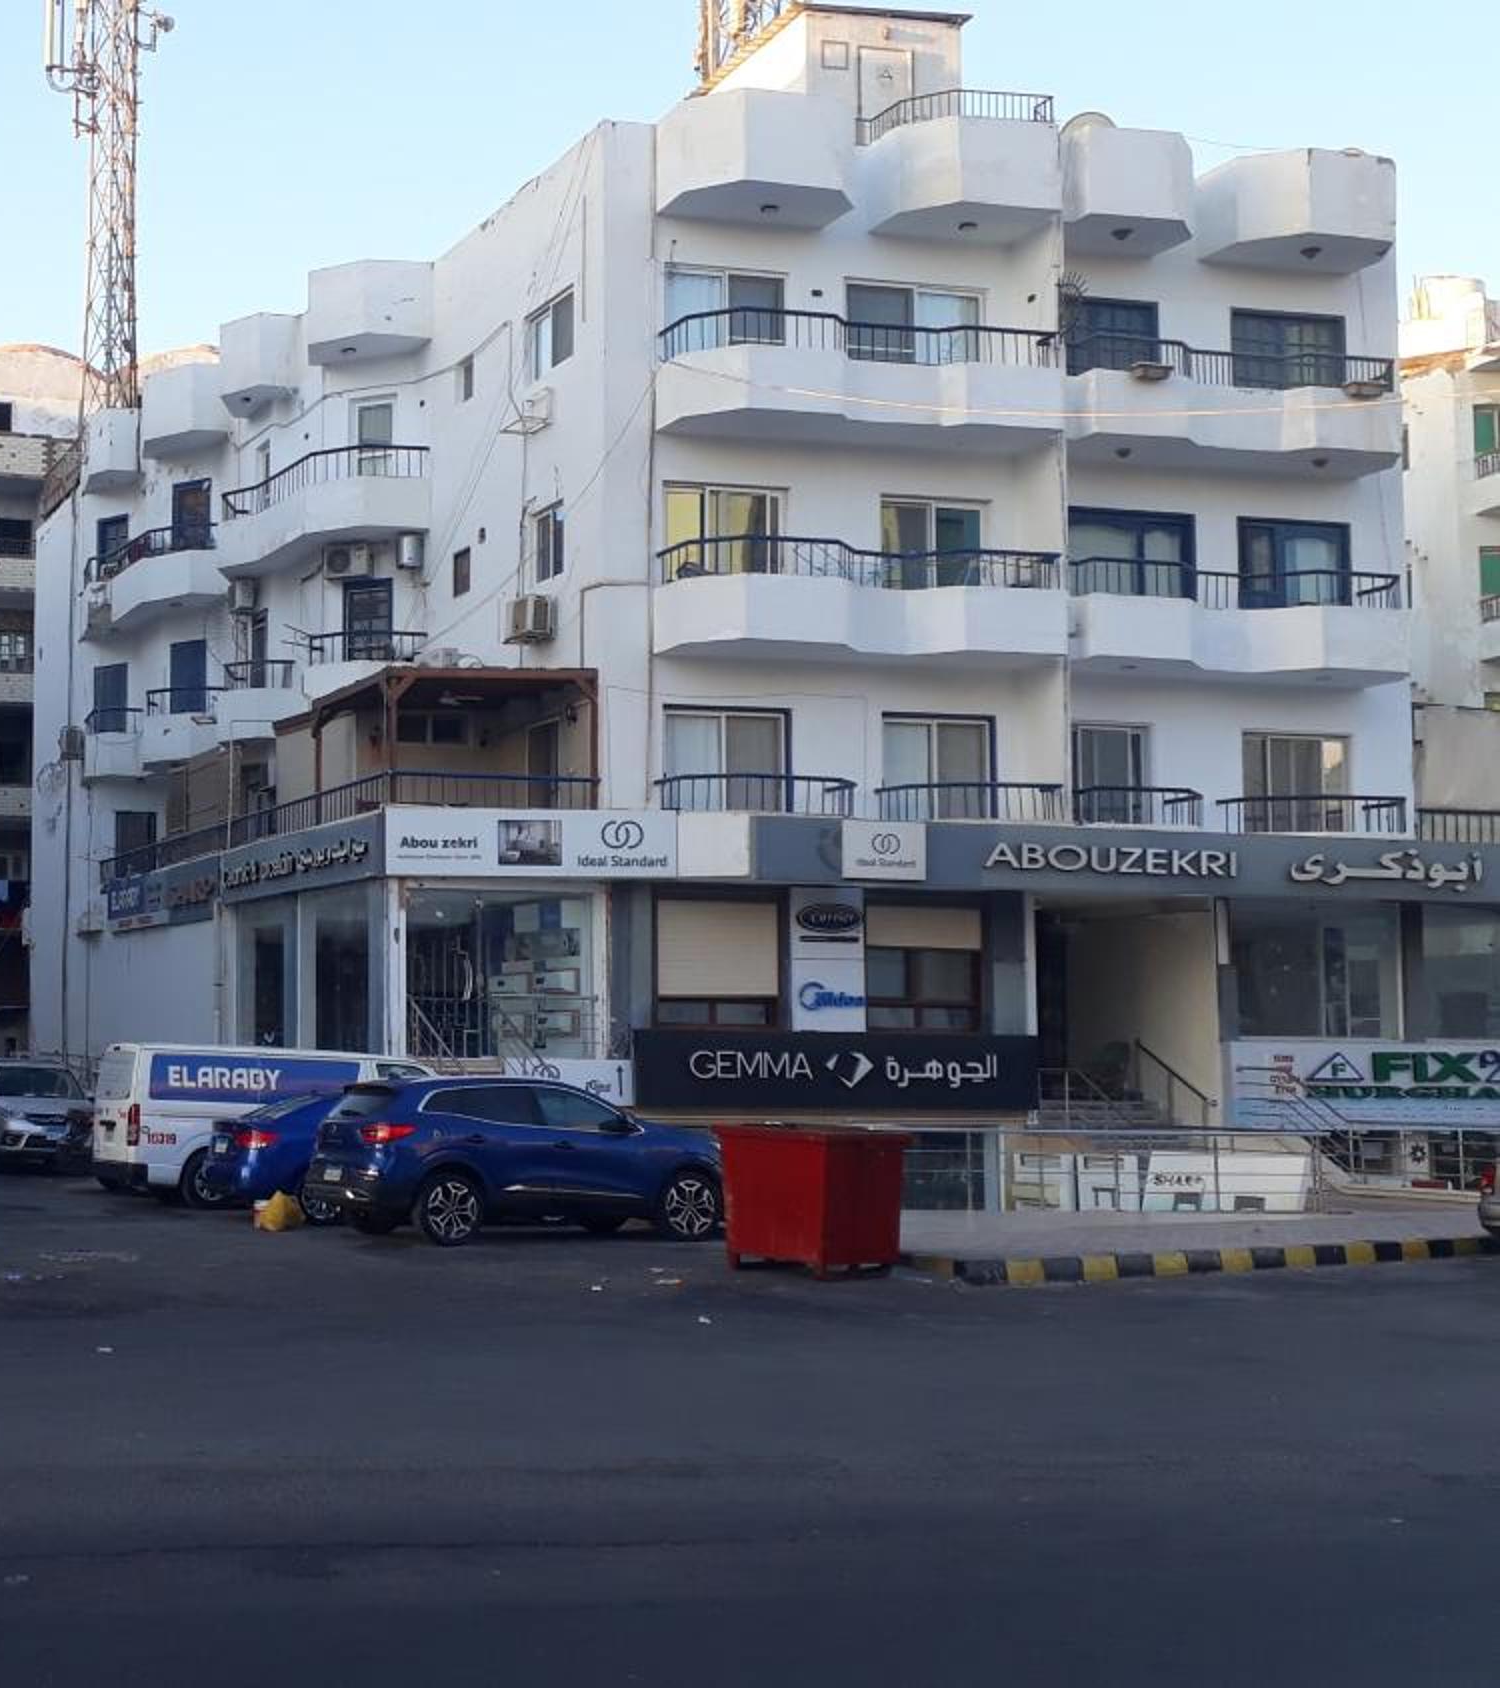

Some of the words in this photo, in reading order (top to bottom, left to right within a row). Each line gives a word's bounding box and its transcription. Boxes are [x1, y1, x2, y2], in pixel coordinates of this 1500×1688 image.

[399, 836, 438, 849] Abou
[441, 836, 478, 849] zekri
[577, 855, 609, 868] Ideal
[611, 855, 668, 868] Standard
[985, 842, 1237, 878] ABOUZEKRI
[167, 1065, 281, 1090] ELARABY
[689, 1051, 813, 1080] GEMMA
[886, 1054, 998, 1088] الجوهرة
